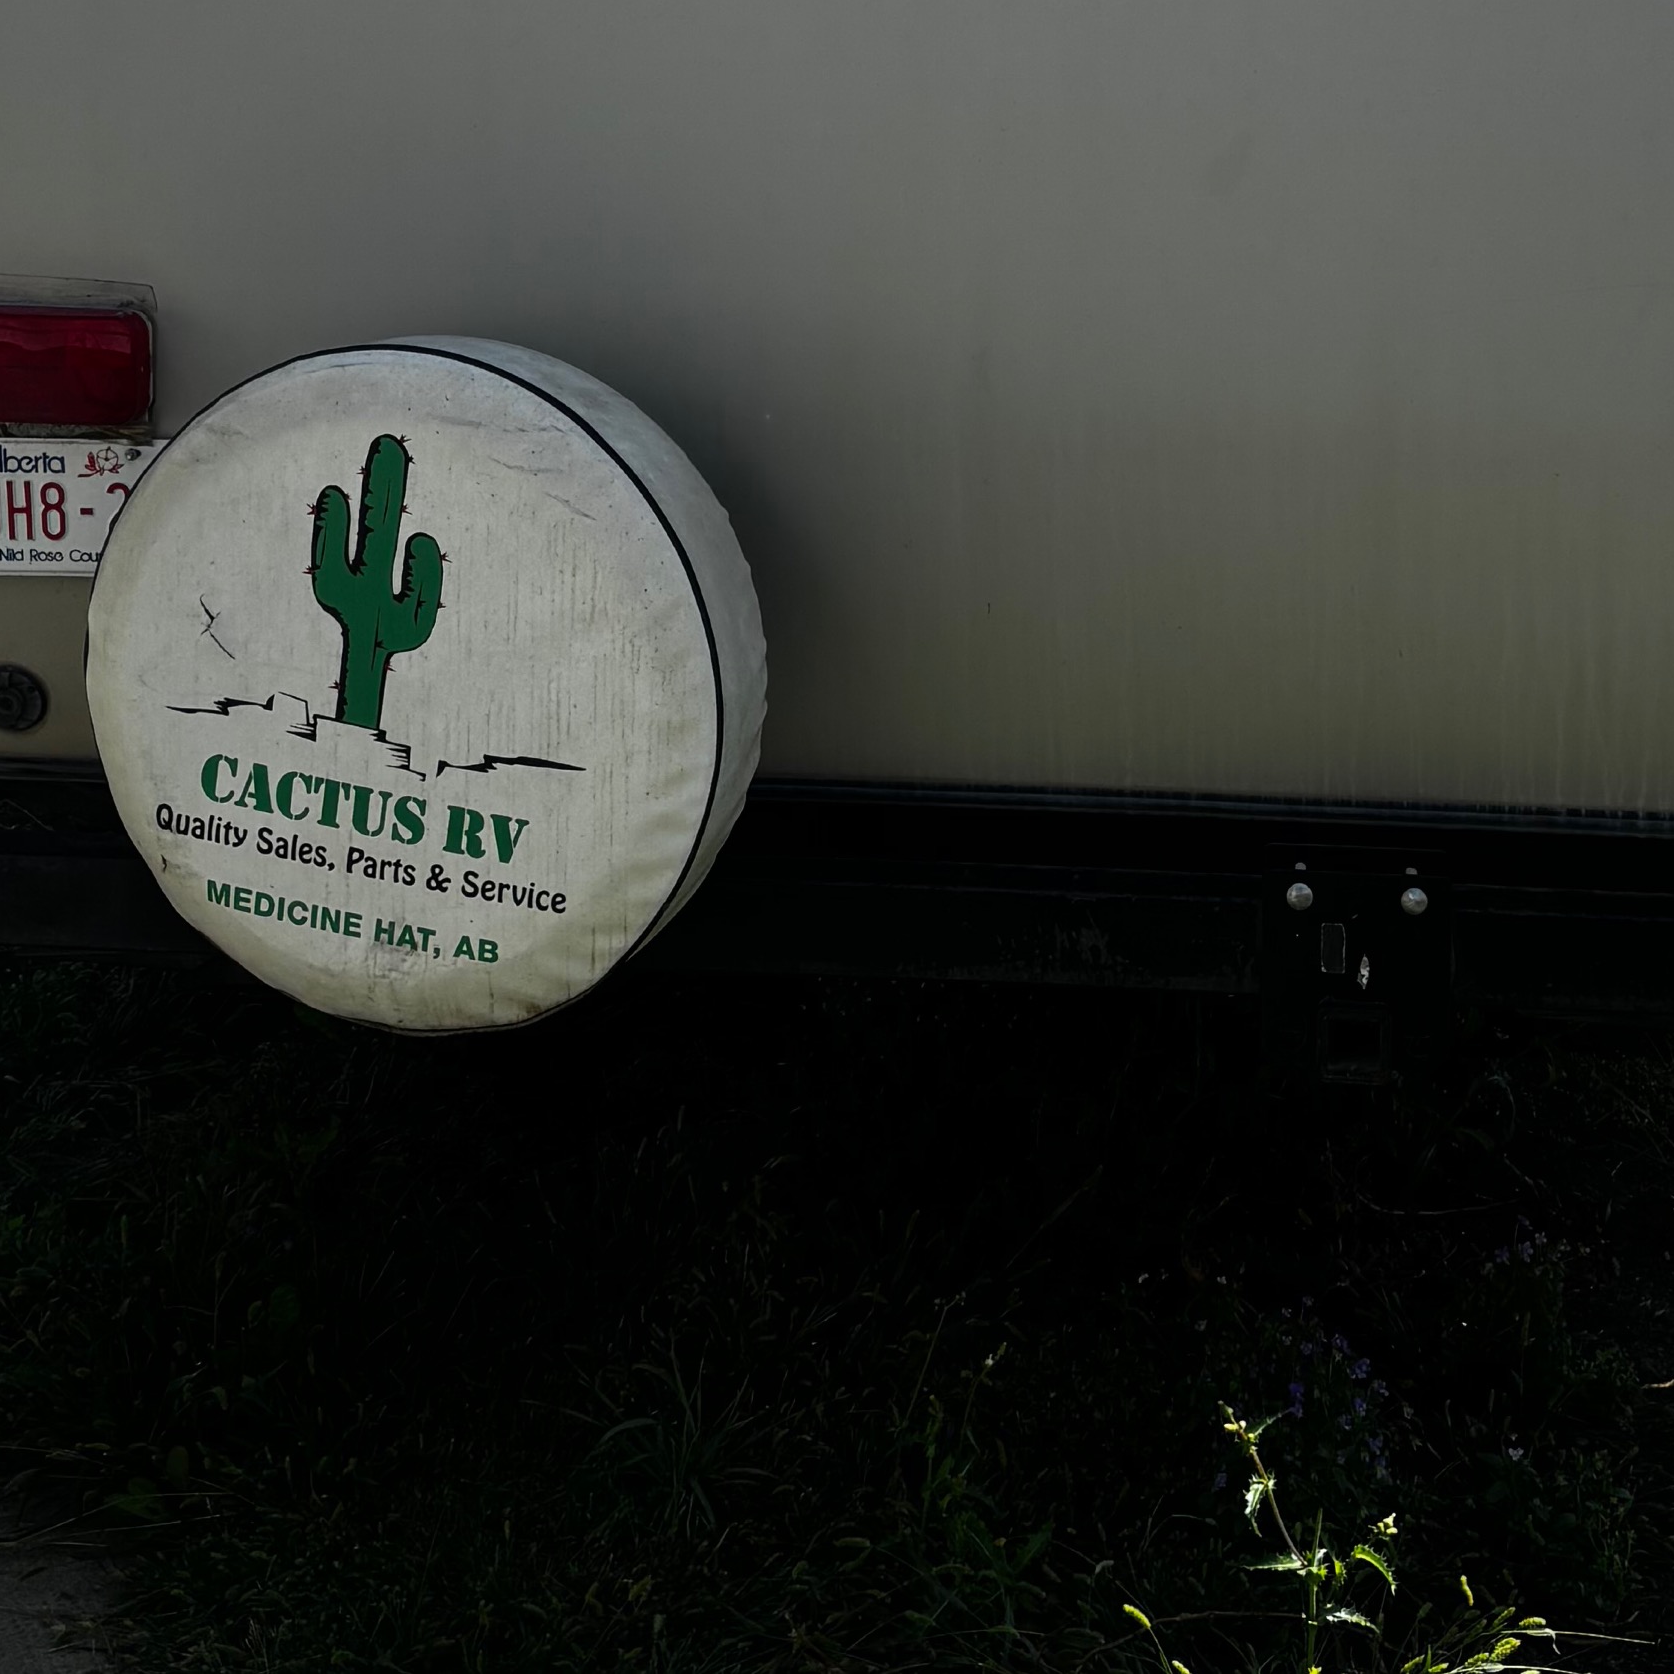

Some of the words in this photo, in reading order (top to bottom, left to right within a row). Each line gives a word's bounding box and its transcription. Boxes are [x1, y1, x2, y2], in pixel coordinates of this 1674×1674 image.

[29, 548, 65, 563] Rose
[200, 753, 427, 846] CACTUS
[442, 804, 530, 865] RV
[155, 803, 248, 848] Quality
[256, 826, 336, 872] Sales,
[346, 845, 417, 887] Parts
[425, 863, 452, 894] &
[461, 870, 567, 915] Service
[206, 878, 363, 939] MEDICINE
[373, 917, 441, 960] HAT,
[452, 934, 500, 964] AB
